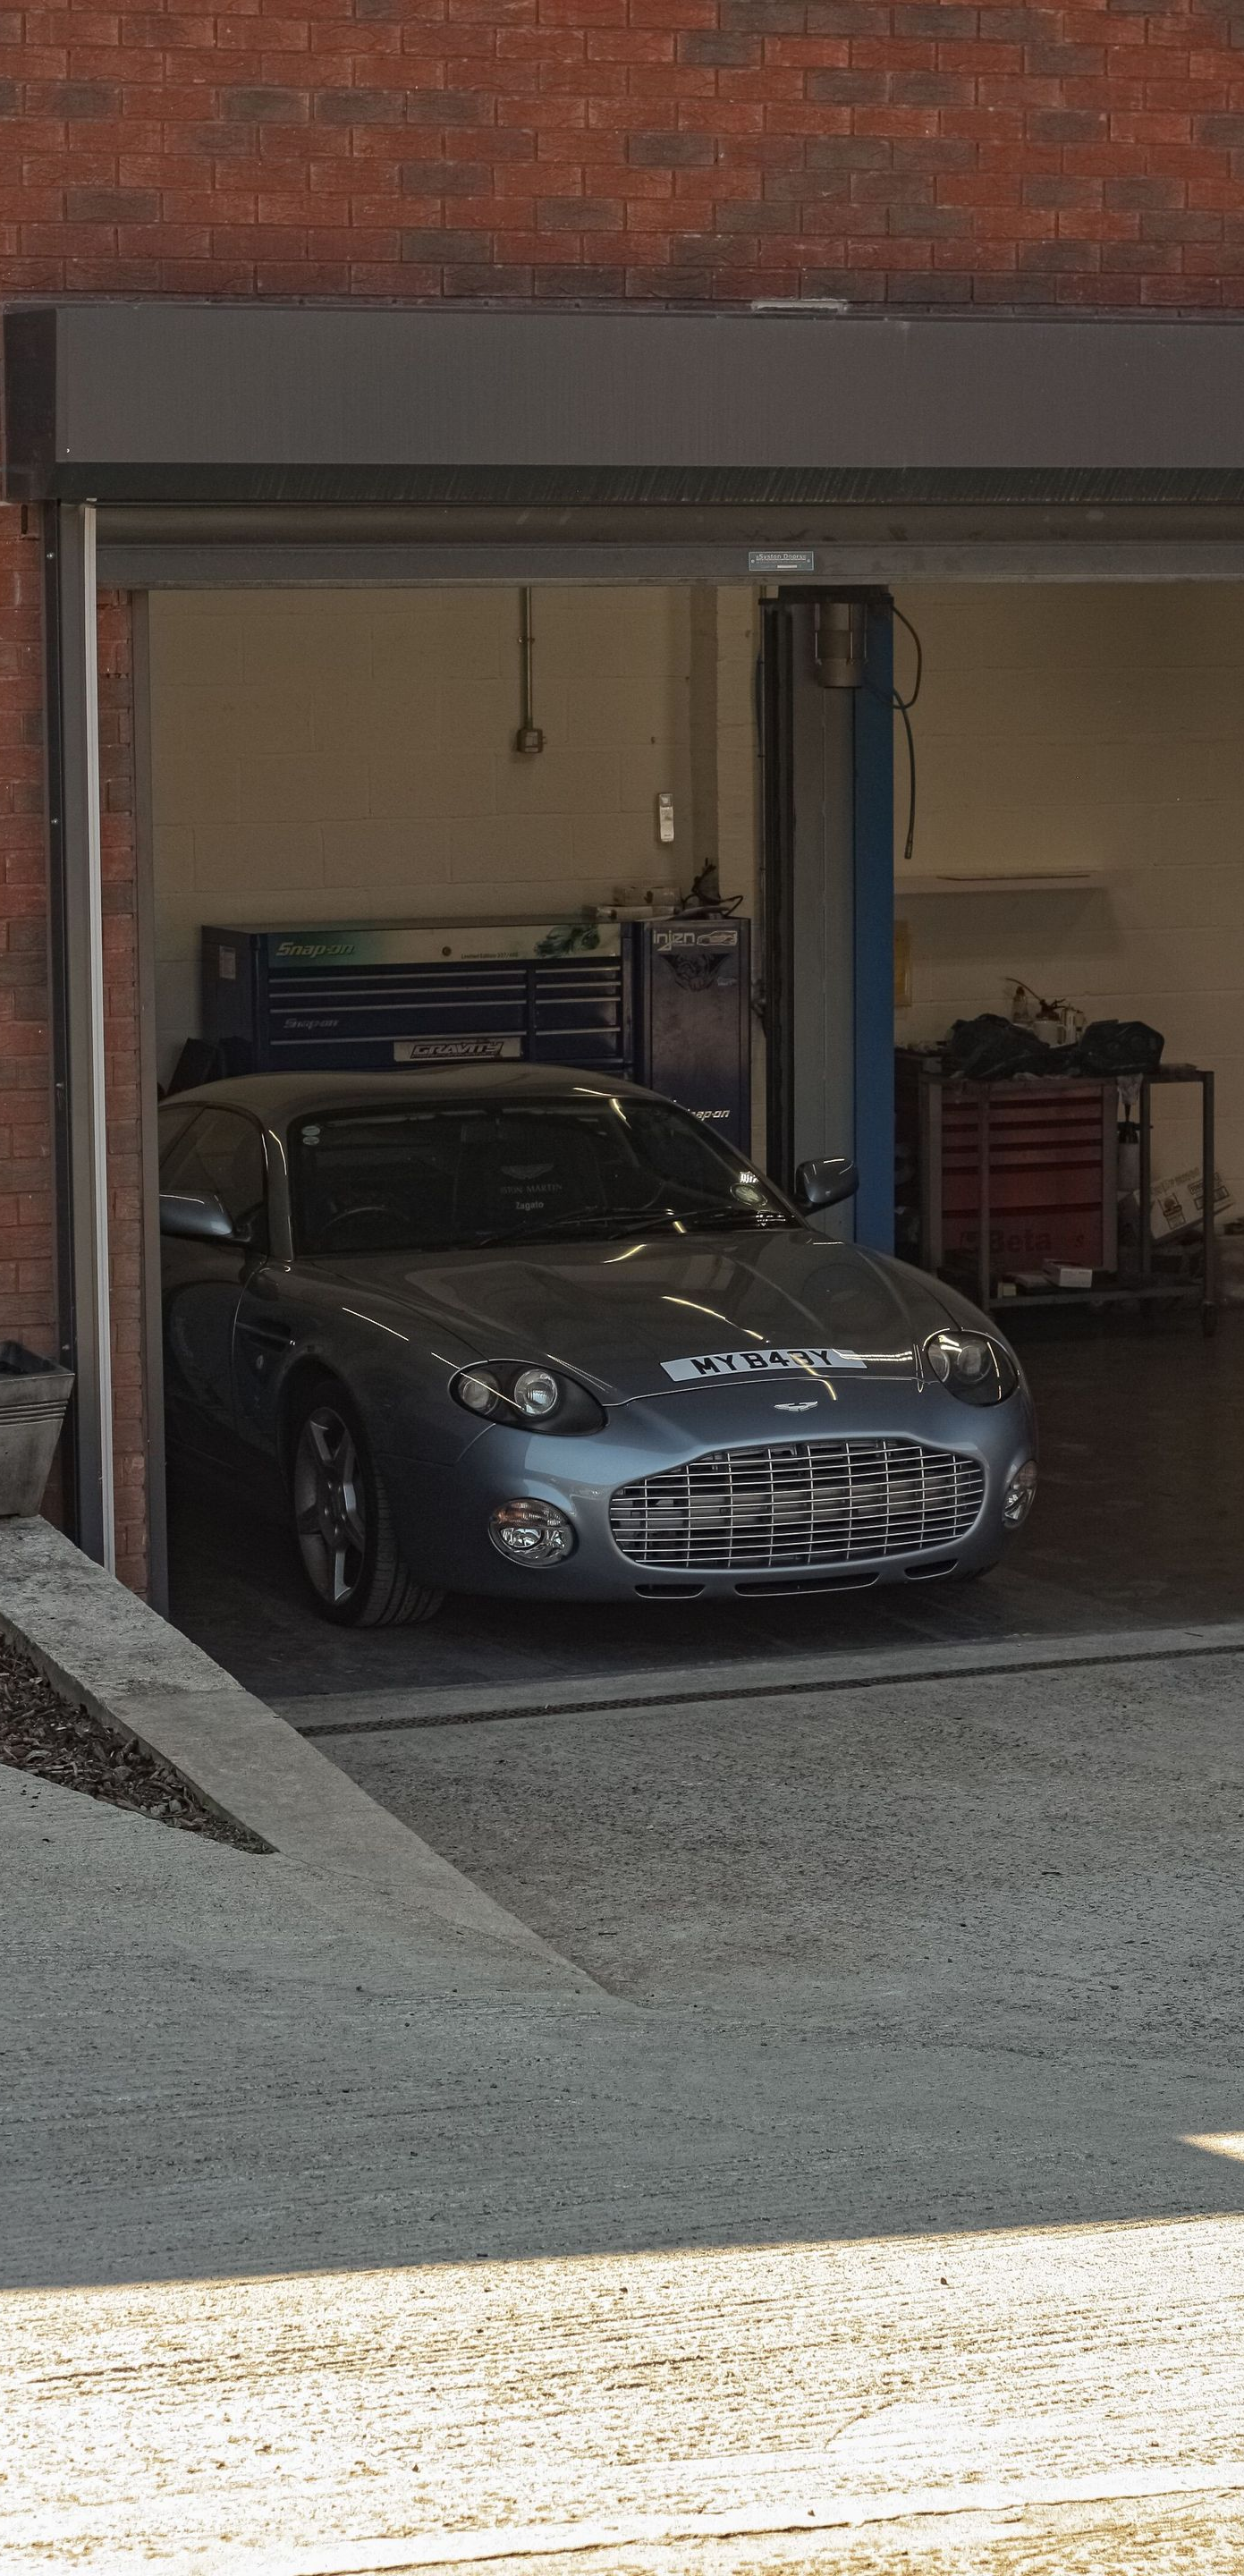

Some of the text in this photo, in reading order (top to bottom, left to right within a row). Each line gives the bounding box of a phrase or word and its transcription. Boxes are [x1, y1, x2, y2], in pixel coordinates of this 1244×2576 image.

[275, 942, 355, 959] Snap-on
[283, 1018, 339, 1030] Snap-on
[411, 1042, 504, 1057] GRAVITY
[691, 1109, 731, 1122] ap-on
[516, 1200, 545, 1211] Zagato
[988, 1229, 1052, 1253] Beta
[690, 1354, 737, 1375] MY
